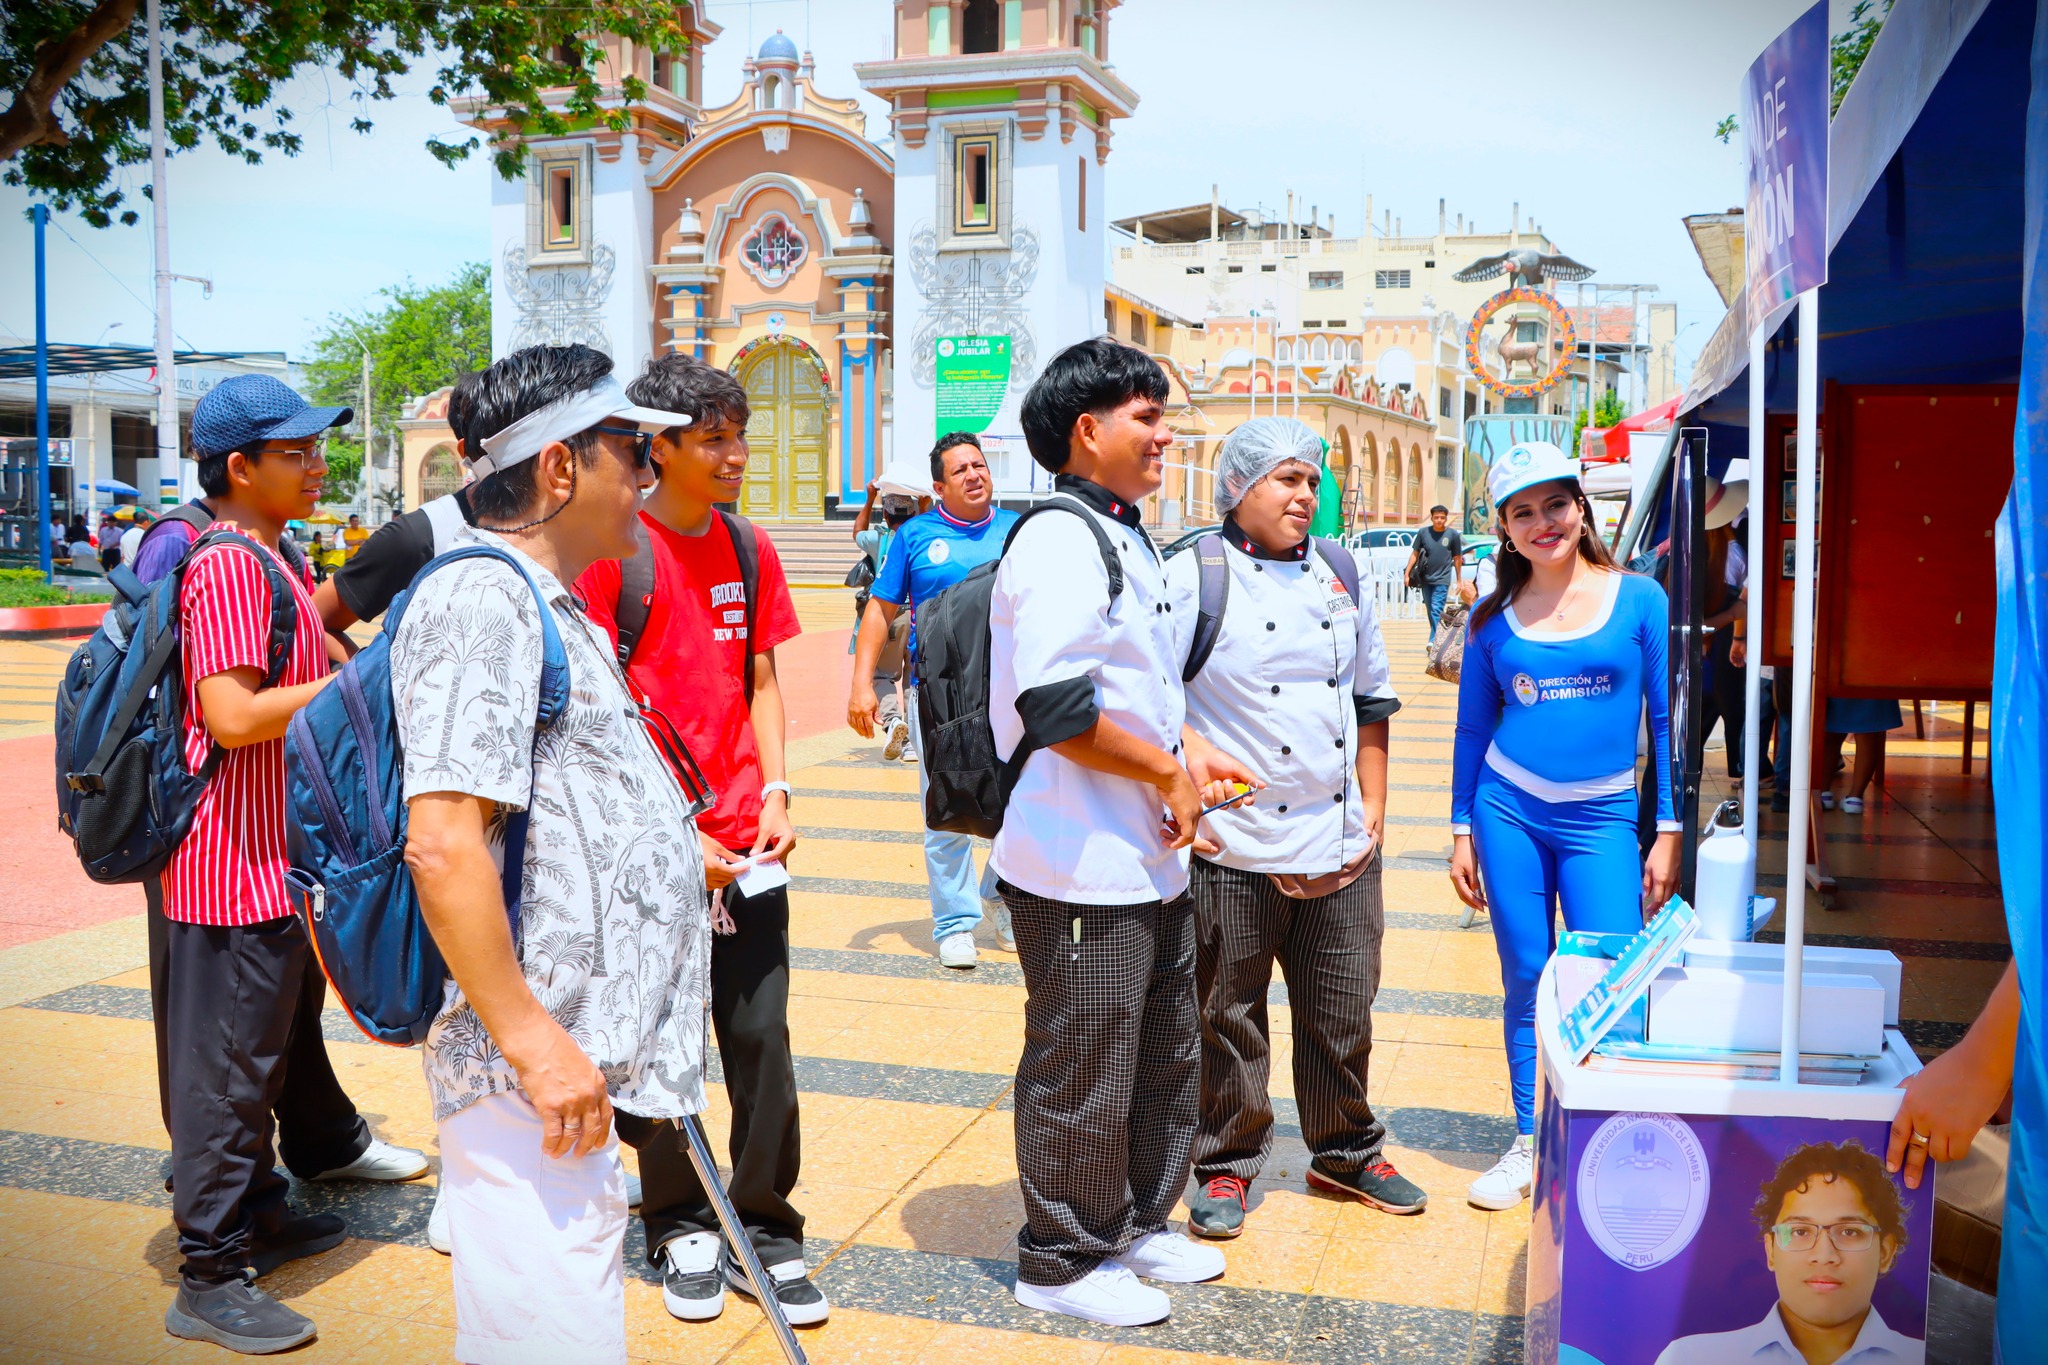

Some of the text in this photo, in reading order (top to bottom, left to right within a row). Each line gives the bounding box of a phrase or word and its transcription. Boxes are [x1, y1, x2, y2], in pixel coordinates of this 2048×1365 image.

[1763, 75, 1788, 152] DE
[958, 339, 989, 347] IGLESIA
[957, 347, 991, 355] JUBILAR
[198, 377, 210, 391] de
[710, 582, 747, 608] BROOKL
[713, 627, 748, 640] NEW YOR
[1539, 674, 1610, 687] DIRECCIÓN DE
[1541, 684, 1611, 701] ADMISIÓN
[1587, 1112, 1701, 1182] UNIVERSIDAD NACIONAL DE TUMBES
[1625, 1252, 1654, 1264] PERU
